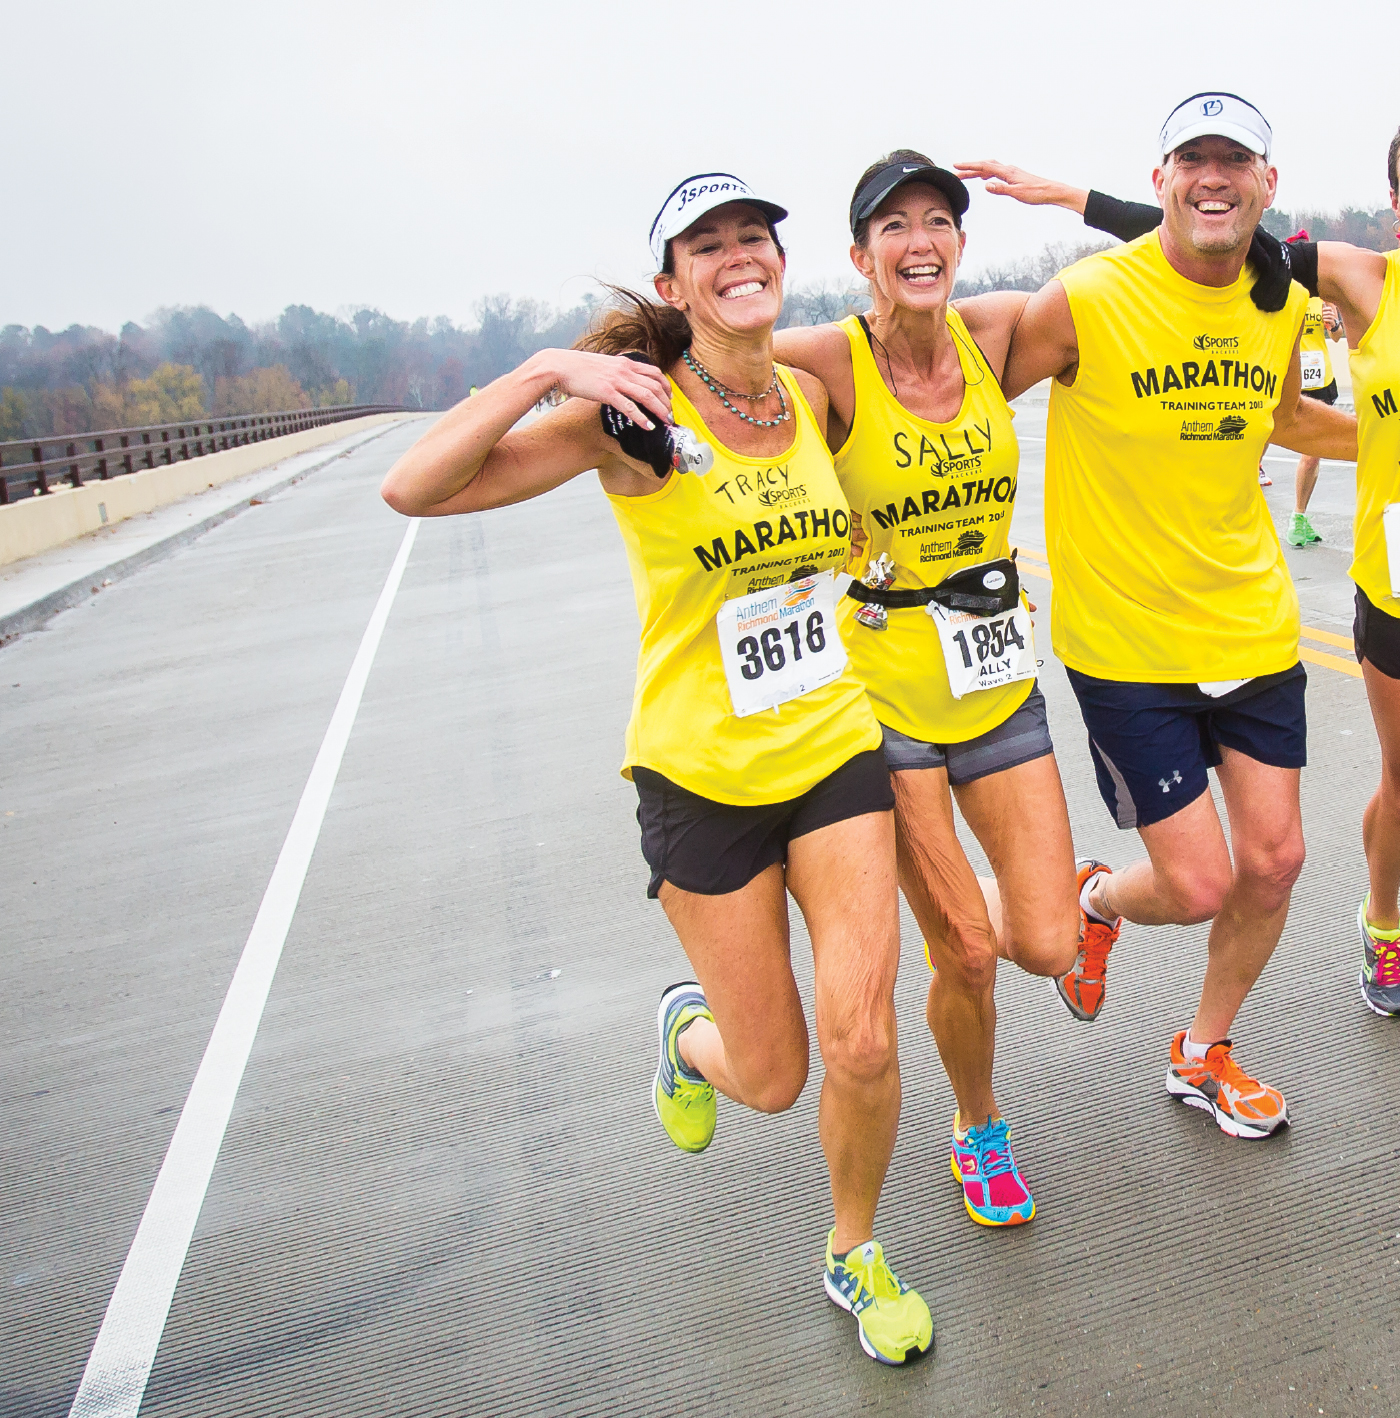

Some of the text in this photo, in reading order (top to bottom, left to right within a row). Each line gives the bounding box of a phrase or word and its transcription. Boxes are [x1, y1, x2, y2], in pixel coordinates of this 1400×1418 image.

[1205, 336, 1239, 348] SPORTS
[1130, 360, 1277, 399] MARATHON
[1303, 368, 1321, 380] 624
[1160, 401, 1216, 410] TRAINING
[1217, 401, 1246, 410] TEAM
[1181, 420, 1213, 432] Anthem
[894, 418, 992, 469] SALLY
[1180, 432, 1244, 441] Richmond Marathon
[943, 456, 981, 472] SPORTS
[714, 464, 789, 504] TRACY
[770, 485, 807, 502] SPORTS
[899, 521, 954, 538] TRAINING
[955, 515, 985, 528] TEAM
[919, 541, 952, 554] Anthem
[731, 558, 792, 576] TRAINING
[794, 551, 824, 563] TEAM
[919, 552, 952, 563] Richmond
[748, 574, 785, 586] Anthem
[736, 598, 778, 621] Anthem
[737, 597, 815, 632] Richmond Marathon
[736, 610, 826, 680] 3616
[952, 616, 1025, 668] 1854
[978, 658, 1011, 677] ALLY
[979, 677, 1003, 687] Wave
